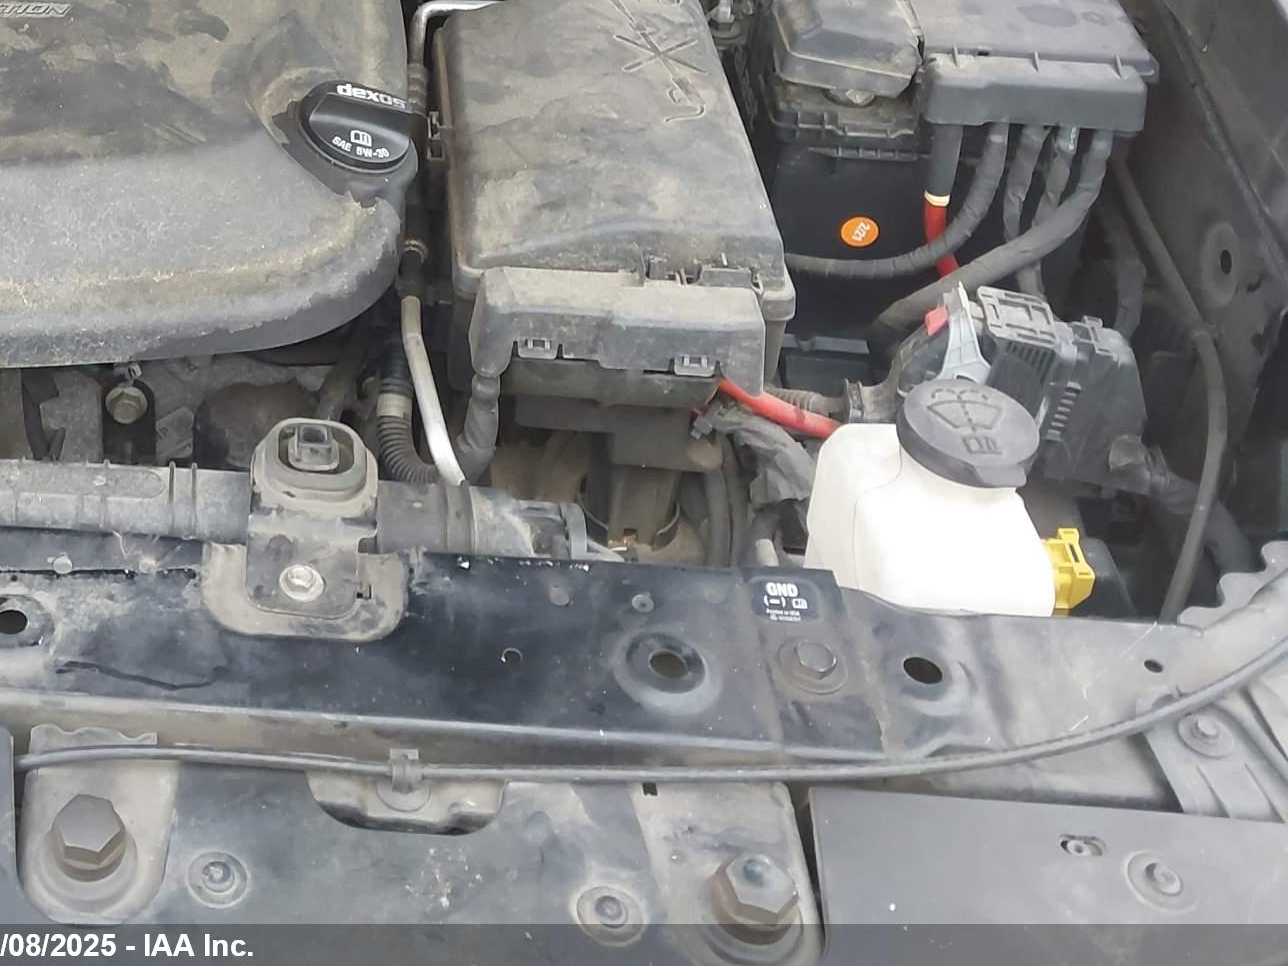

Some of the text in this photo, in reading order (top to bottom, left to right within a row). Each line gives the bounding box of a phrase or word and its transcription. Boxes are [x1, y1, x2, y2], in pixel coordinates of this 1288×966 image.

[336, 83, 407, 109] dexos
[332, 135, 390, 158] SAE 5W-30
[766, 582, 799, 597] GND
